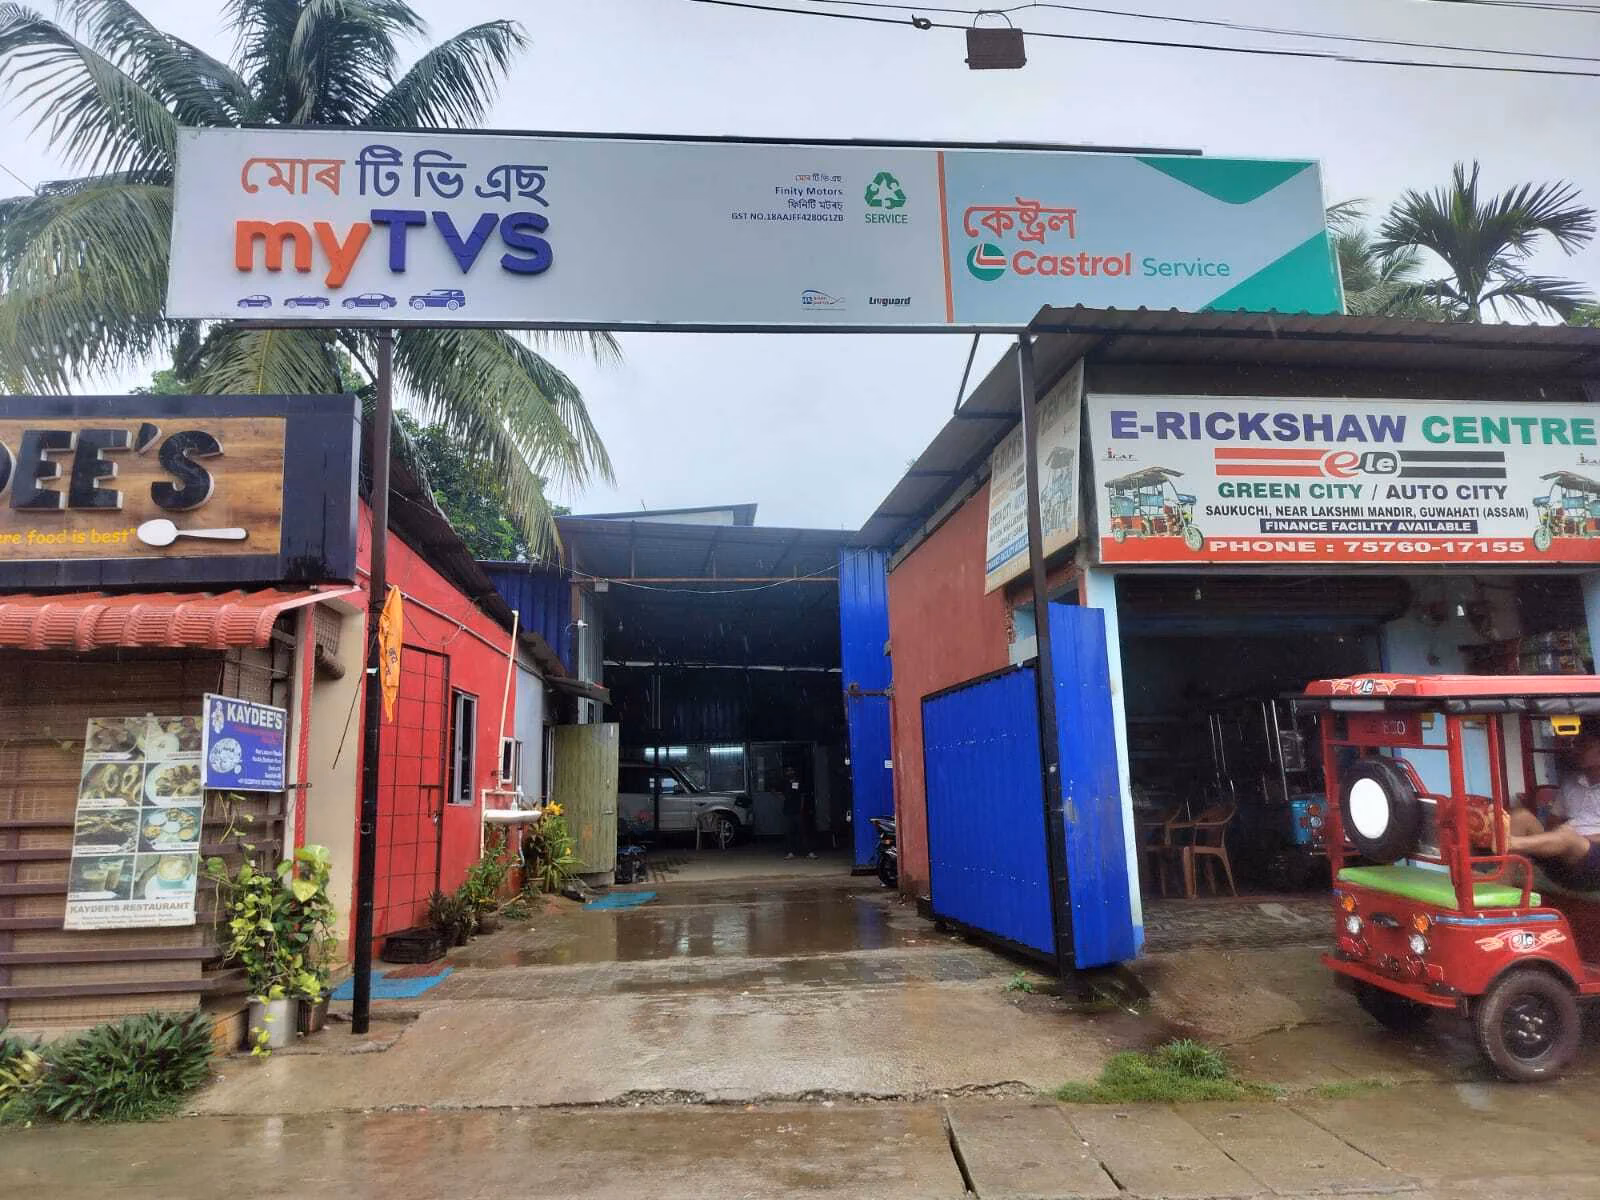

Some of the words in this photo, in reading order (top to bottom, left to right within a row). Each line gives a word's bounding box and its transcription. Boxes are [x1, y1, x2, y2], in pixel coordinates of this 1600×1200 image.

[241, 158, 346, 195] মোৰ
[355, 145, 403, 197] টি
[412, 150, 467, 198] ভি
[475, 166, 549, 207] এছ
[775, 186, 803, 197] Finity
[806, 187, 843, 196] Motors
[731, 212, 748, 220] GST
[865, 212, 908, 224] SERVICE
[235, 209, 554, 288] myTVS
[1012, 251, 1132, 277] Castrol
[1142, 257, 1230, 277] Service
[1110, 411, 1407, 443] E-RICKSHAW
[1421, 415, 1598, 446] CENTRE
[0, 422, 224, 511] EE'S
[1218, 482, 1302, 500] GREEN
[1309, 483, 1364, 500] CITY
[1371, 482, 1379, 501] /
[1386, 484, 1450, 501] AUTO
[1456, 484, 1509, 501] CITY
[1206, 505, 1273, 519] SAUKUCHI,
[1275, 506, 1309, 518] NEAR
[1311, 506, 1365, 518] LAKSHMI
[1367, 506, 1418, 519] MANDIR,
[1420, 507, 1480, 519] GUWAHATI
[1482, 507, 1530, 520] (ASSAM)
[1265, 521, 1329, 532] FINANCE
[1332, 522, 1395, 532] FACILITY
[1398, 522, 1473, 533] AVAILABLE
[27, 528, 68, 546] food
[72, 530, 86, 545] is
[1209, 540, 1318, 554] PHONE
[1343, 540, 1526, 555] 75760-17155
[227, 702, 283, 730] KAYDEE'S
[122, 902, 190, 911] RESTAURANT
